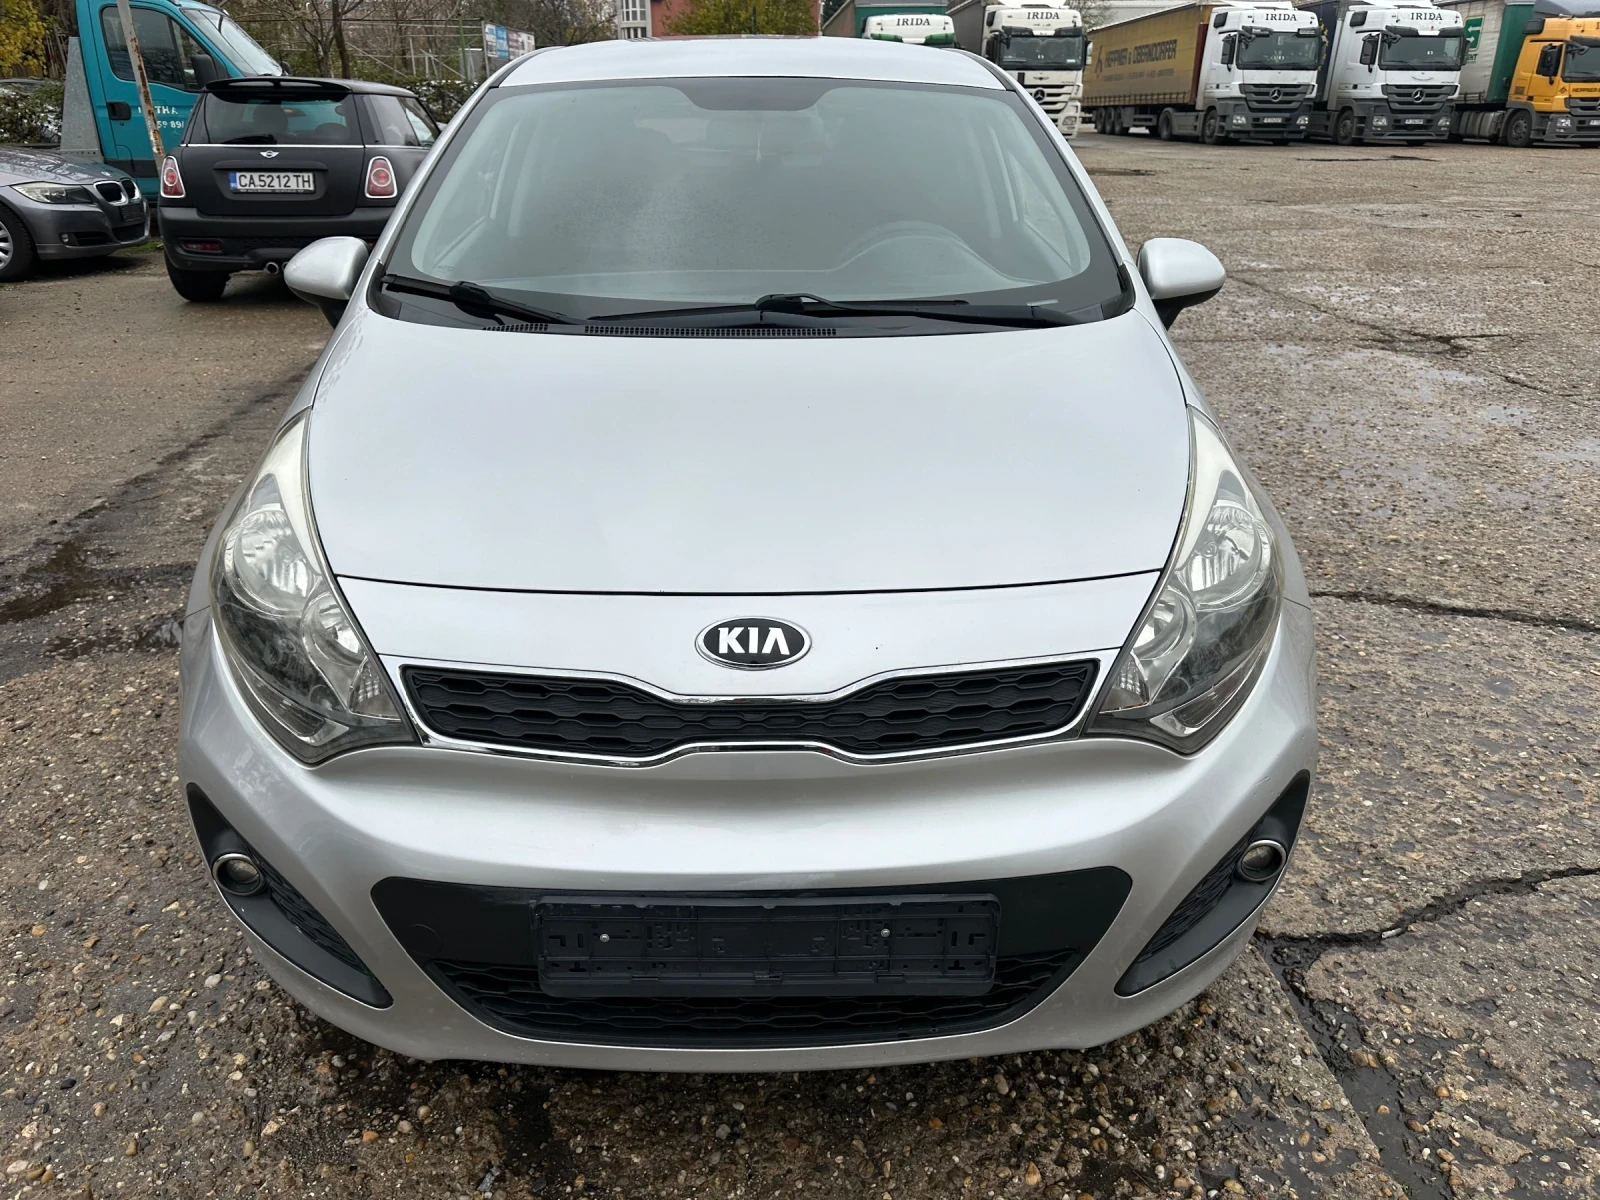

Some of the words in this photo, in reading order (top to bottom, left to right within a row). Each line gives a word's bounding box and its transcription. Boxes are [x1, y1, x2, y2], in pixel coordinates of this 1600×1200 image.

[1026, 11, 1060, 20] IRIDA
[1265, 13, 1297, 21] IRIDA
[1411, 12, 1443, 20] IRIDA
[896, 17, 931, 26] IRIDA
[717, 626, 791, 655] KIA
